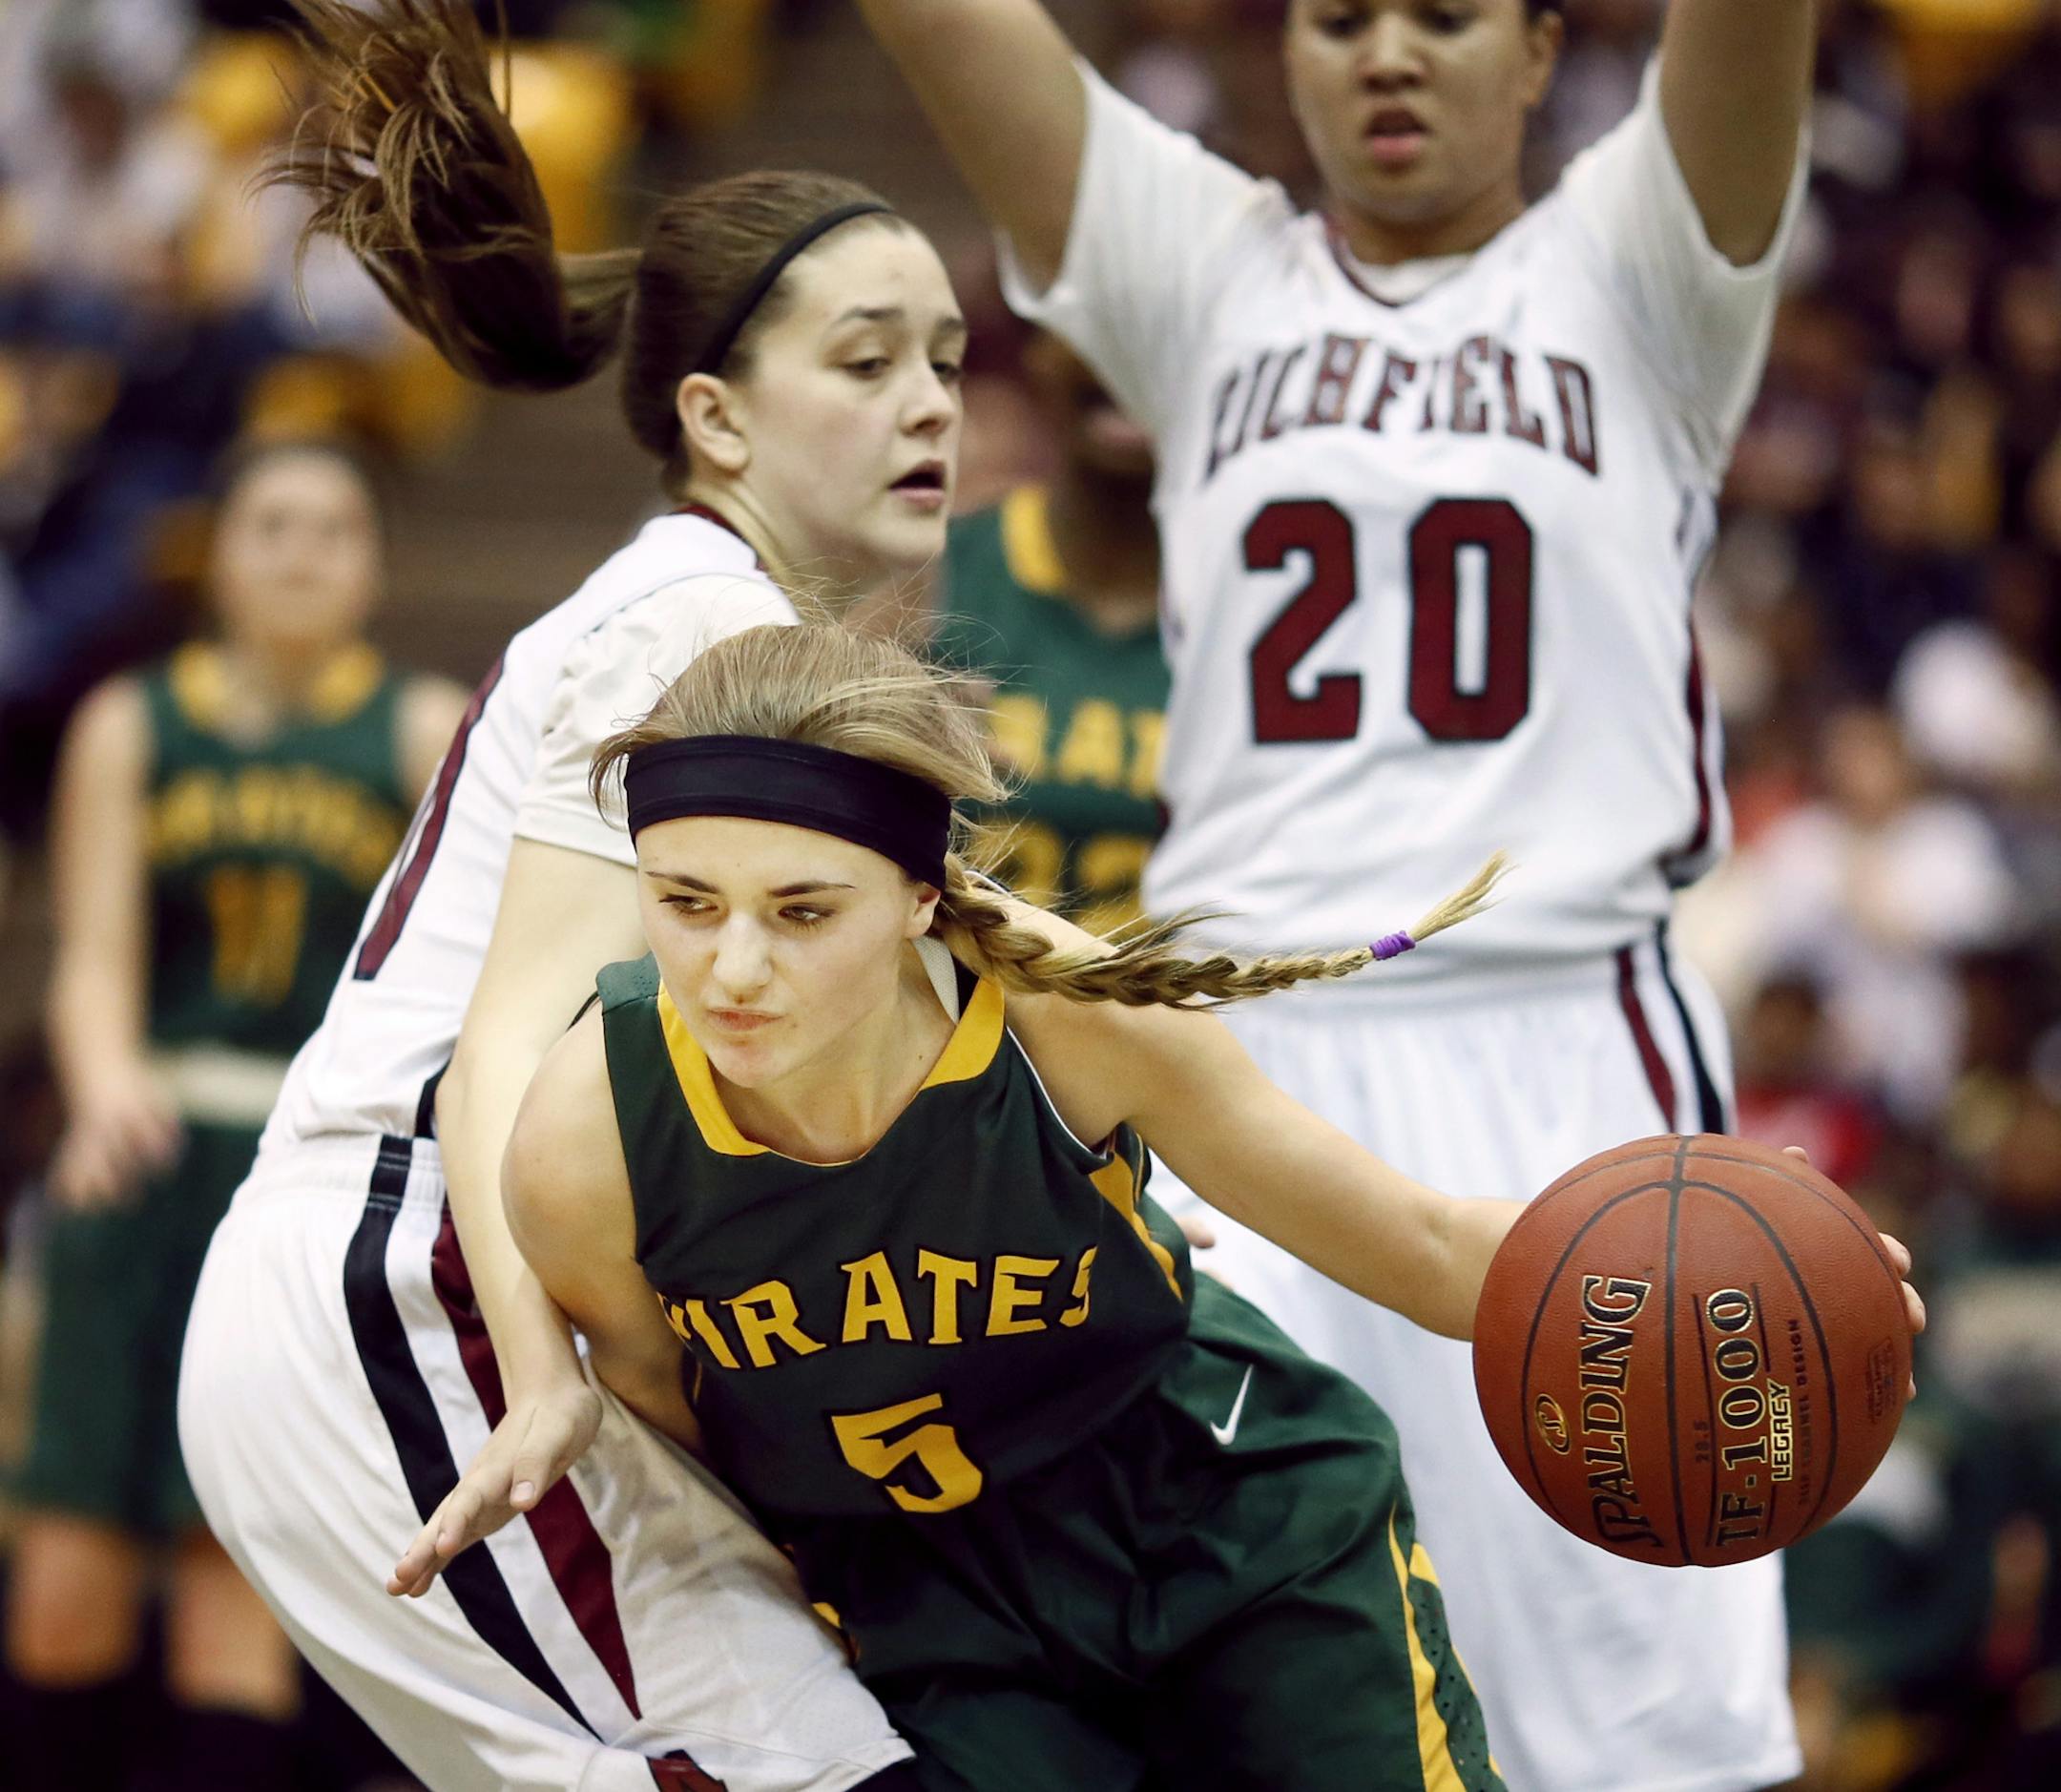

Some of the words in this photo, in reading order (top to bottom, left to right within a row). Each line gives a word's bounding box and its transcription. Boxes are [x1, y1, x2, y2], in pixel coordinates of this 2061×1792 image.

[1242, 497, 1534, 744] 20
[830, 1392, 983, 1513] 5
[1578, 1274, 1664, 1548] SPALDING
[1706, 1288, 1768, 1547] TF-1000
[1766, 1378, 1793, 1481] LEGACY
